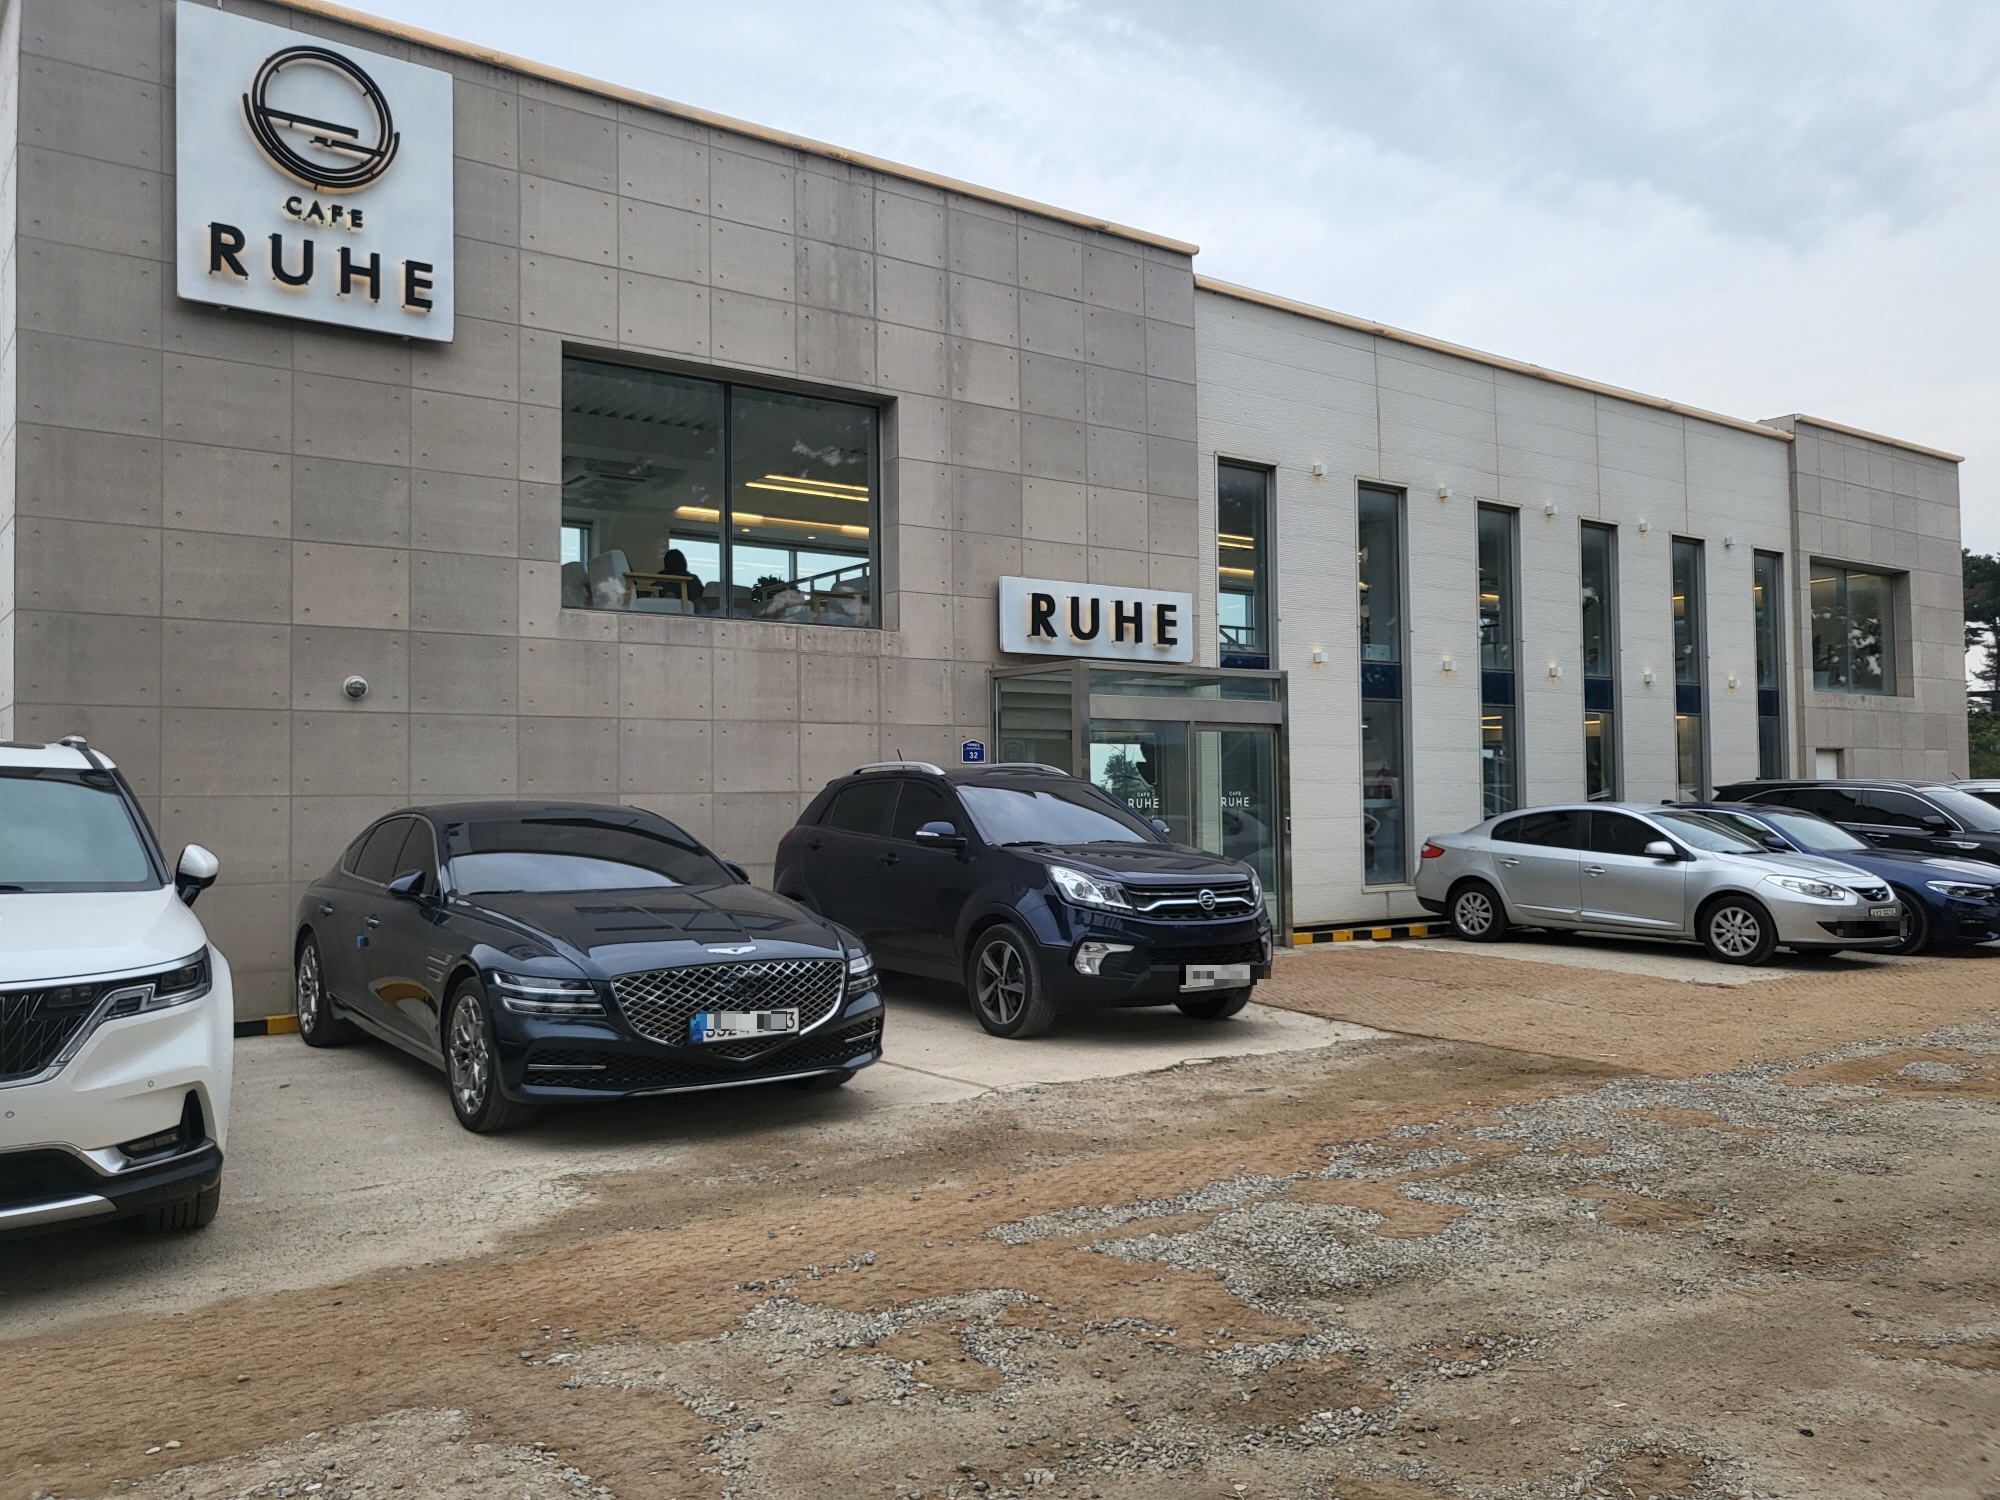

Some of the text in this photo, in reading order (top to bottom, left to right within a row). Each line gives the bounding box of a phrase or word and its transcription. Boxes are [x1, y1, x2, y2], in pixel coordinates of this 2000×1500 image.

[284, 196, 363, 229] CAFE
[209, 222, 433, 310] RUHE
[1031, 592, 1178, 646] RUHE
[969, 751, 979, 759] 32
[1127, 798, 1160, 809] RUHE
[1220, 796, 1250, 807] RUHE
